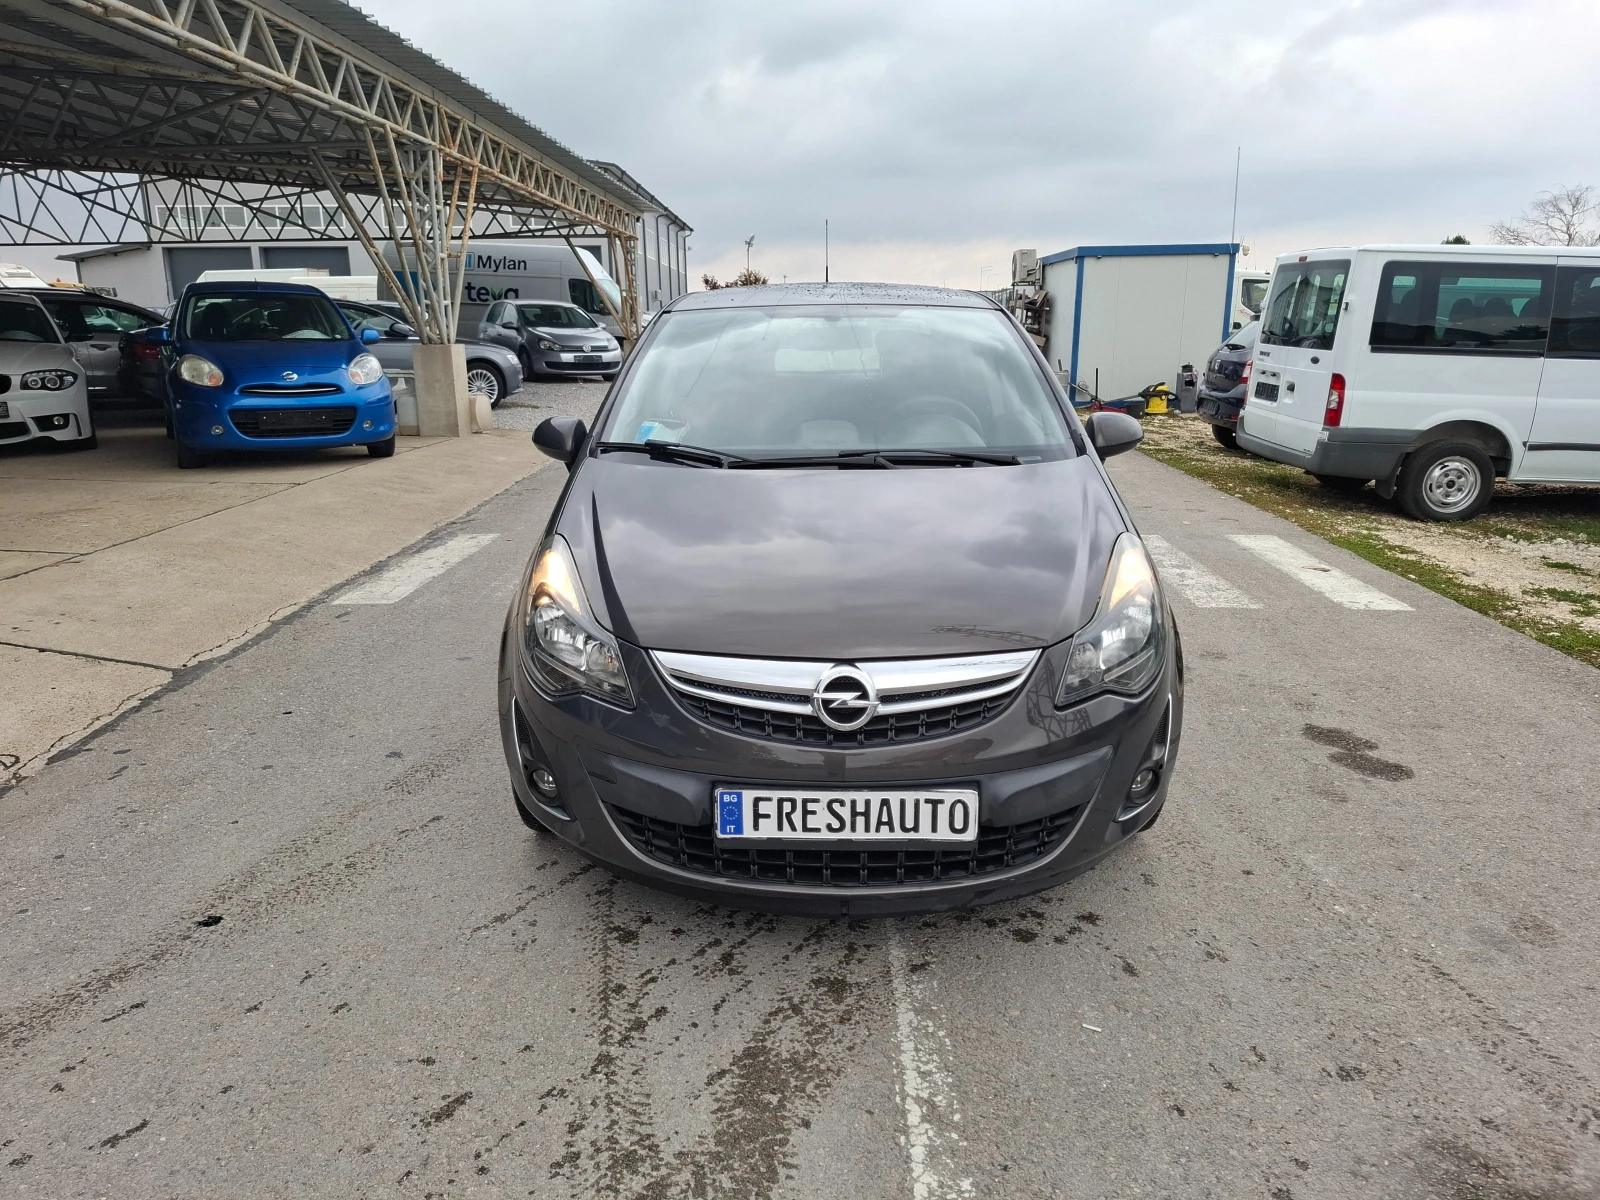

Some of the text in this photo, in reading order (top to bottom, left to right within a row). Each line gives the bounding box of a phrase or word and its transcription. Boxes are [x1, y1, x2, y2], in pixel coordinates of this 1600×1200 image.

[477, 255, 527, 272] Mylan
[465, 282, 519, 302] teva
[723, 795, 738, 803] BG
[752, 797, 970, 834] FRESHAUTO
[726, 825, 735, 833] IT
